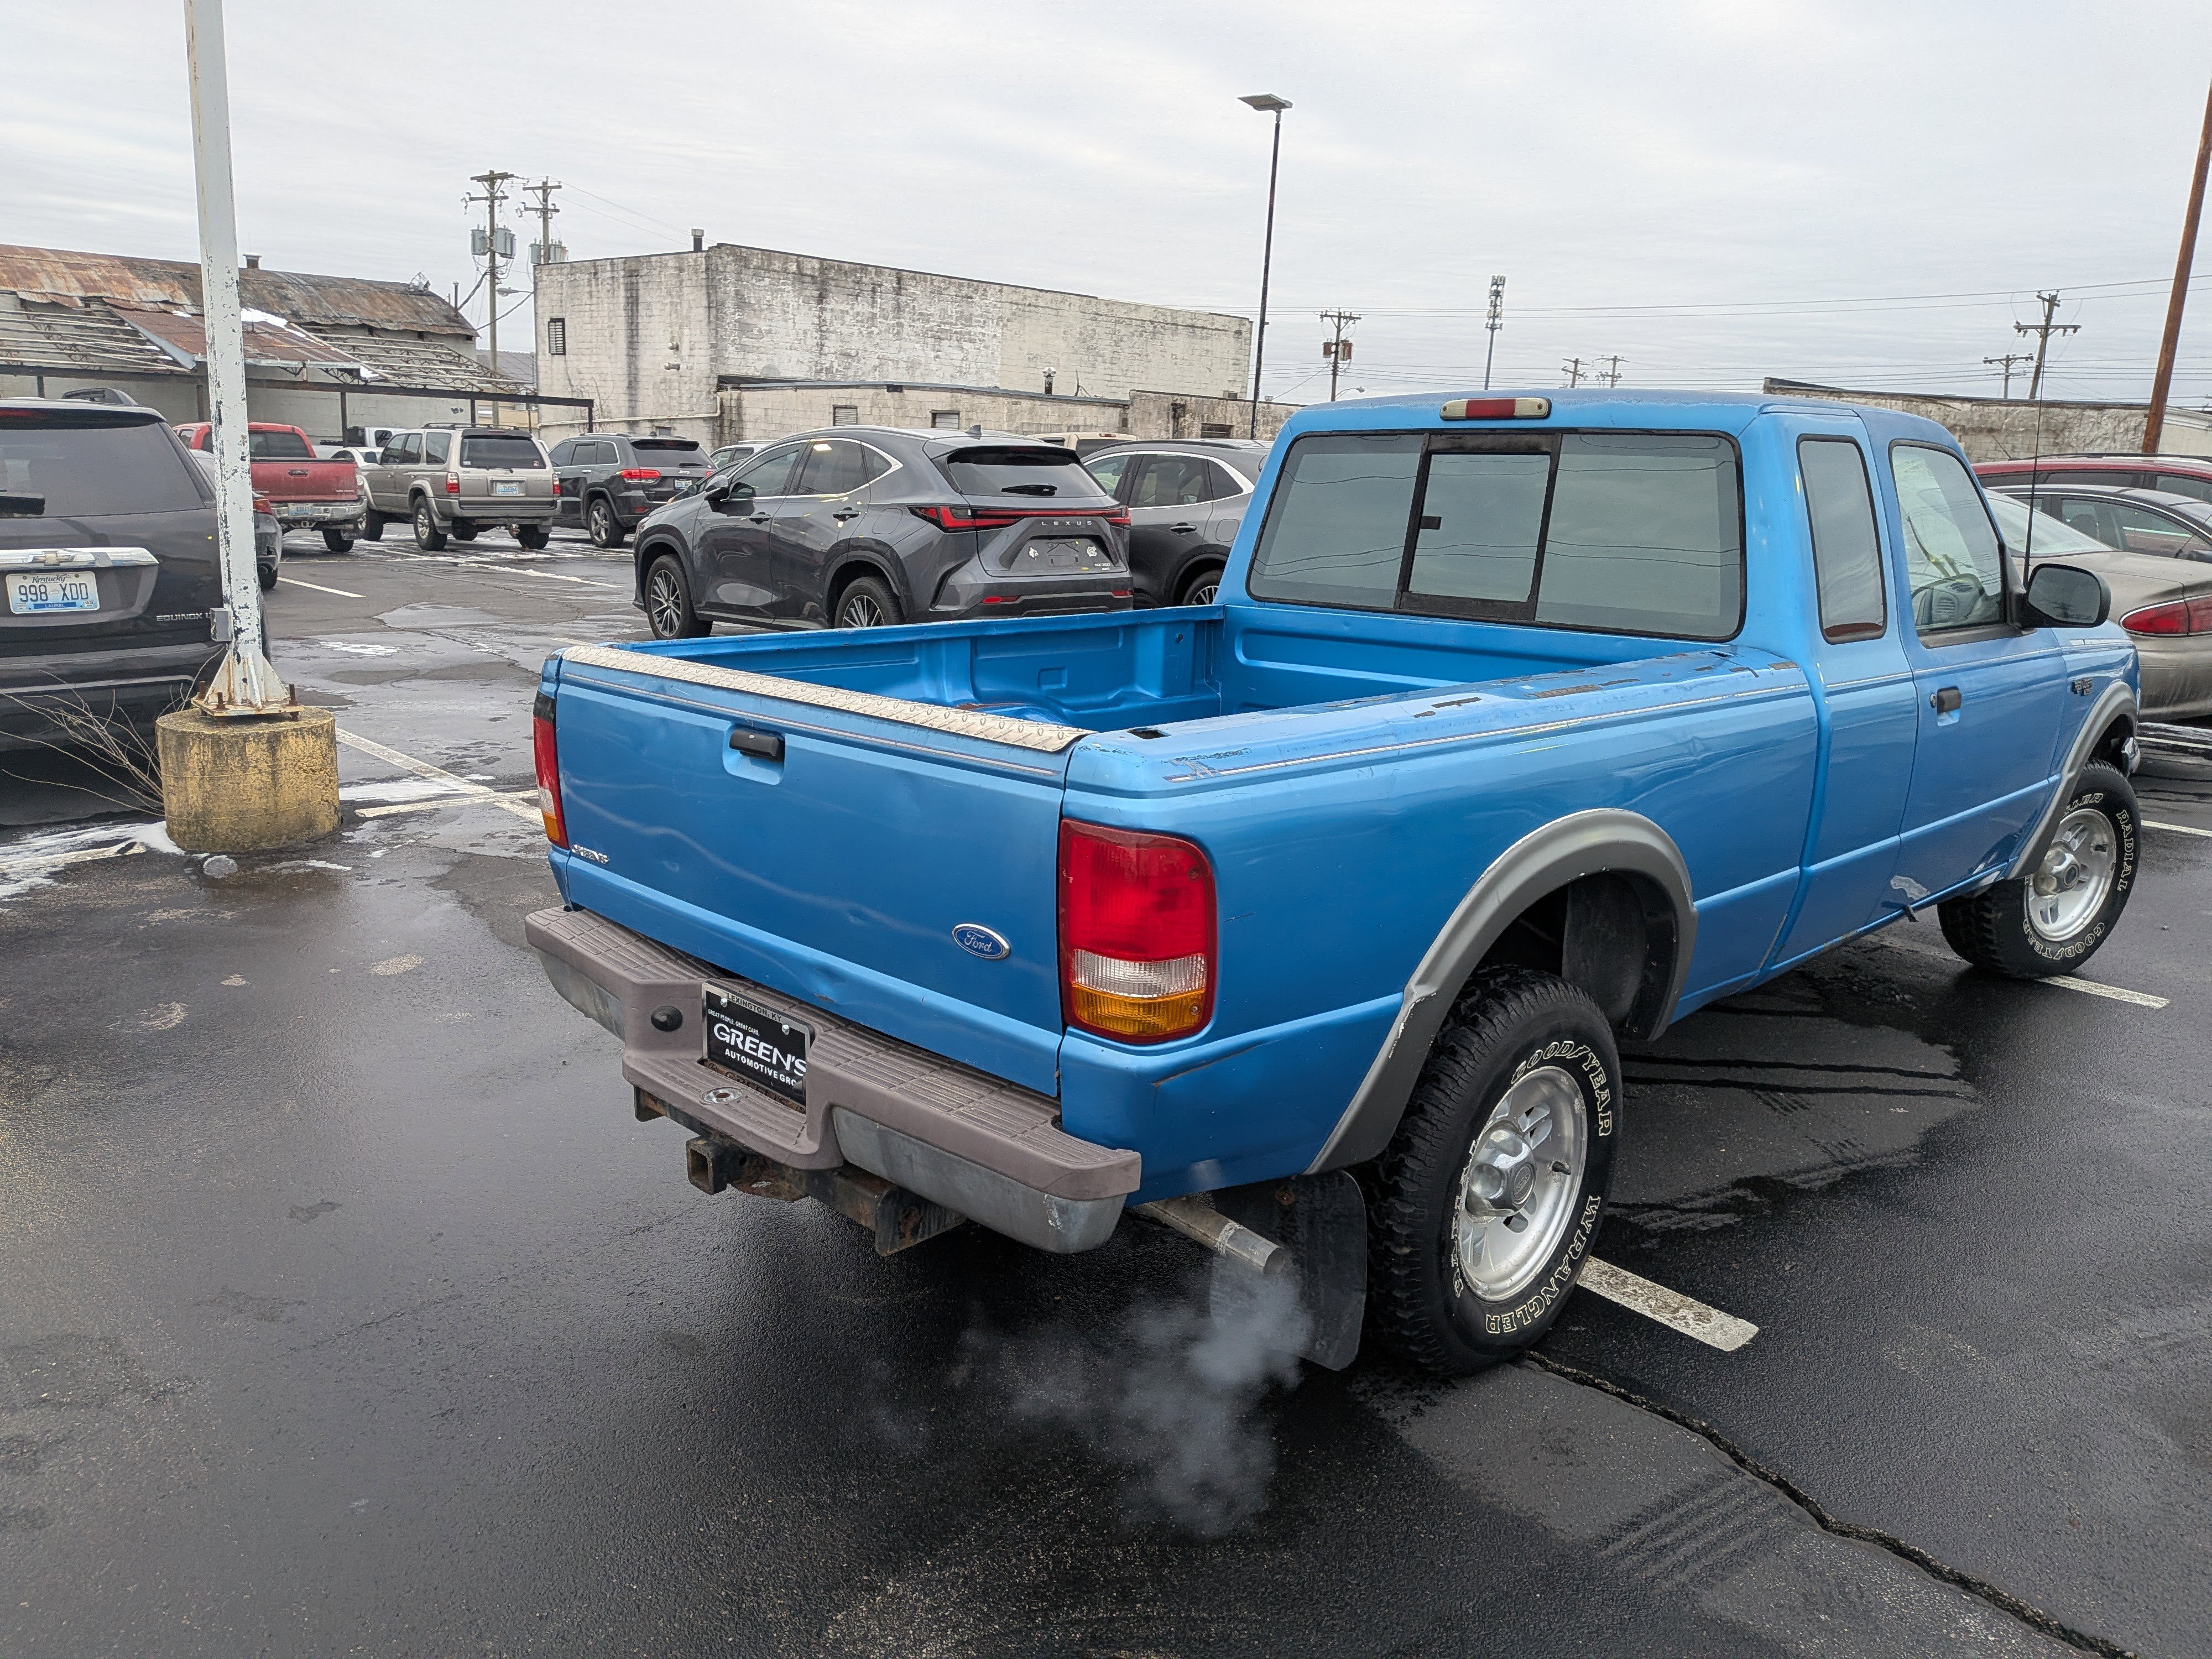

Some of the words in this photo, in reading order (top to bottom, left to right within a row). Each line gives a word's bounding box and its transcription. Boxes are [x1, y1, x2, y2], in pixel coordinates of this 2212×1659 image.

[18, 585, 49, 602] 998
[59, 583, 89, 601] XDD
[156, 613, 202, 621] EQUINOX
[2116, 810, 2134, 891] RADIAL
[964, 931, 993, 953] Ford
[2023, 919, 2105, 960] GOODYEAR
[708, 1009, 719, 1018] GREAT
[735, 1021, 748, 1031] GREAT
[771, 1011, 782, 1022] KY
[714, 1023, 806, 1077] GREEN'S
[725, 1048, 778, 1079] AUTOMOTIVE
[1511, 1041, 1612, 1136] GOODYEAR
[1486, 1194, 1601, 1333] WRANGLER
